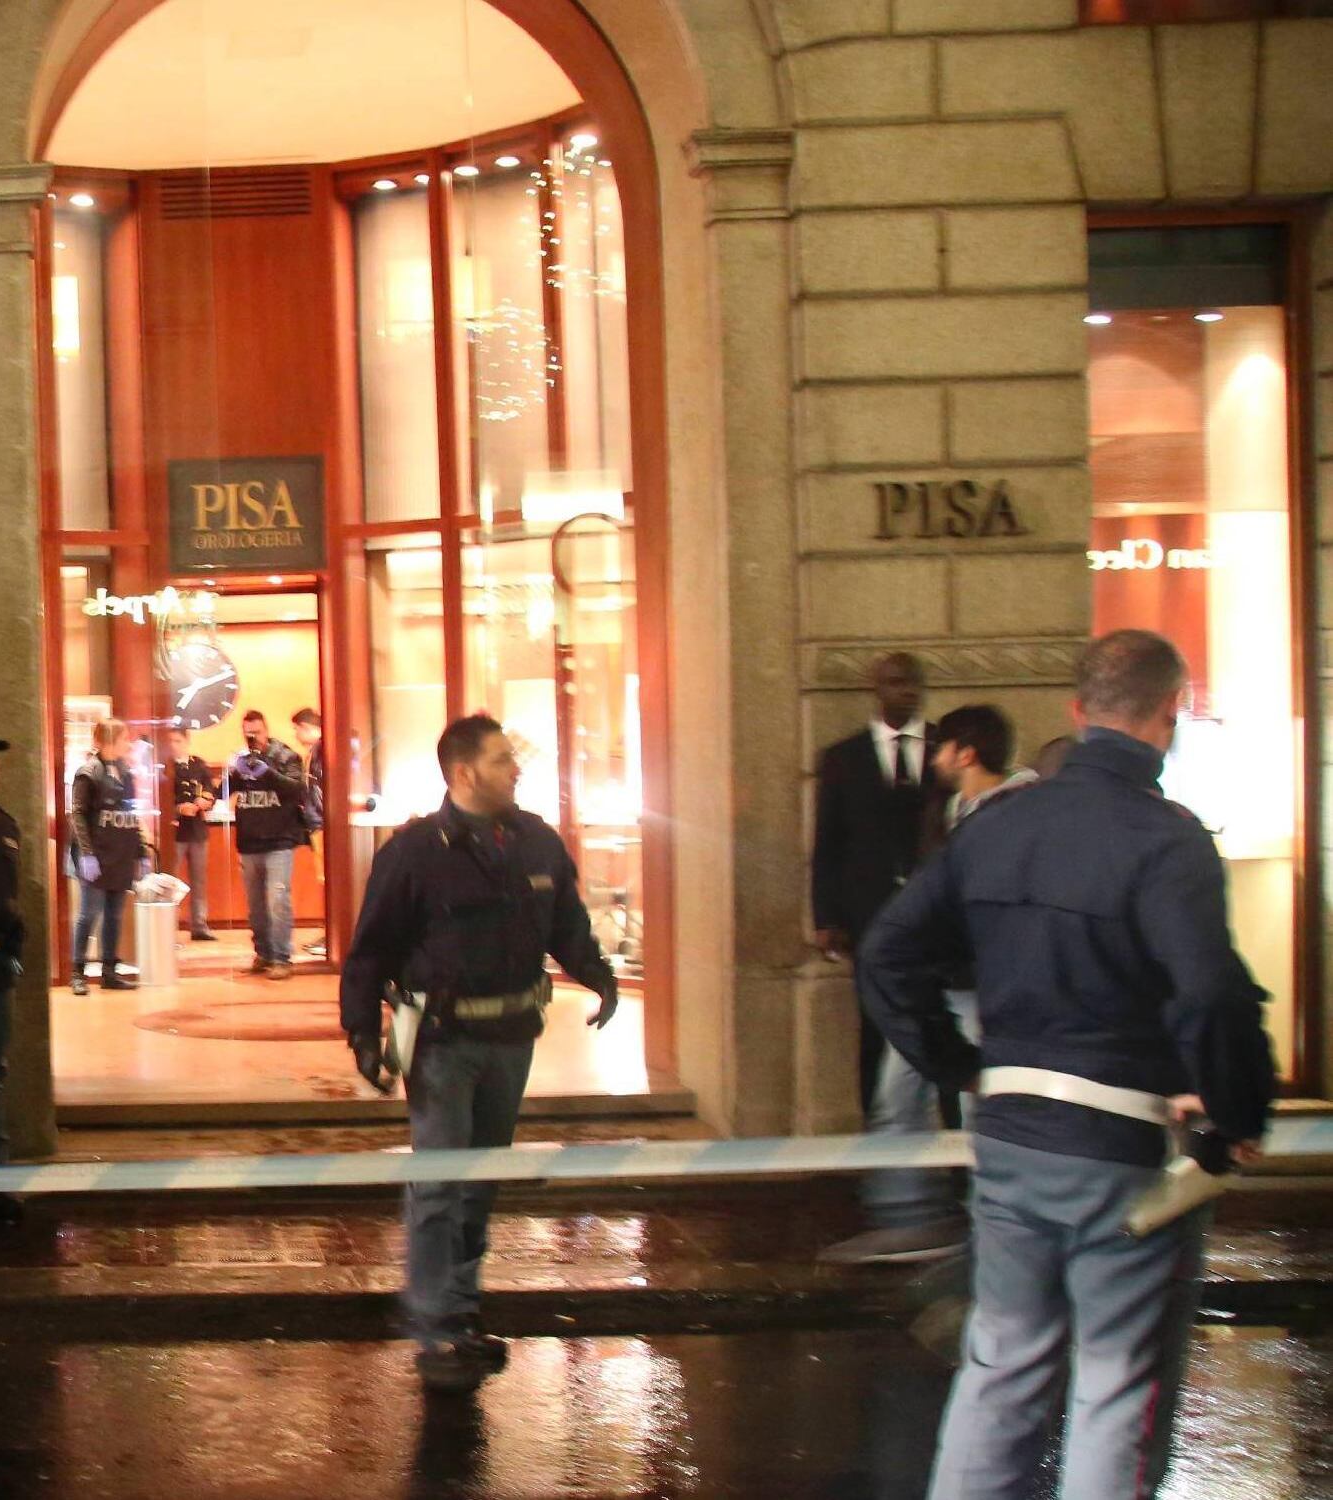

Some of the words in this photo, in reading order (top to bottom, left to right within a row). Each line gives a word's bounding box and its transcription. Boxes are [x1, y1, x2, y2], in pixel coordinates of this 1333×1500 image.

[190, 479, 305, 532] PISA
[873, 479, 1032, 540] PISA
[194, 530, 304, 550] OROLOGERIA
[237, 790, 282, 809] OLIZIA
[99, 809, 139, 829] POLI
